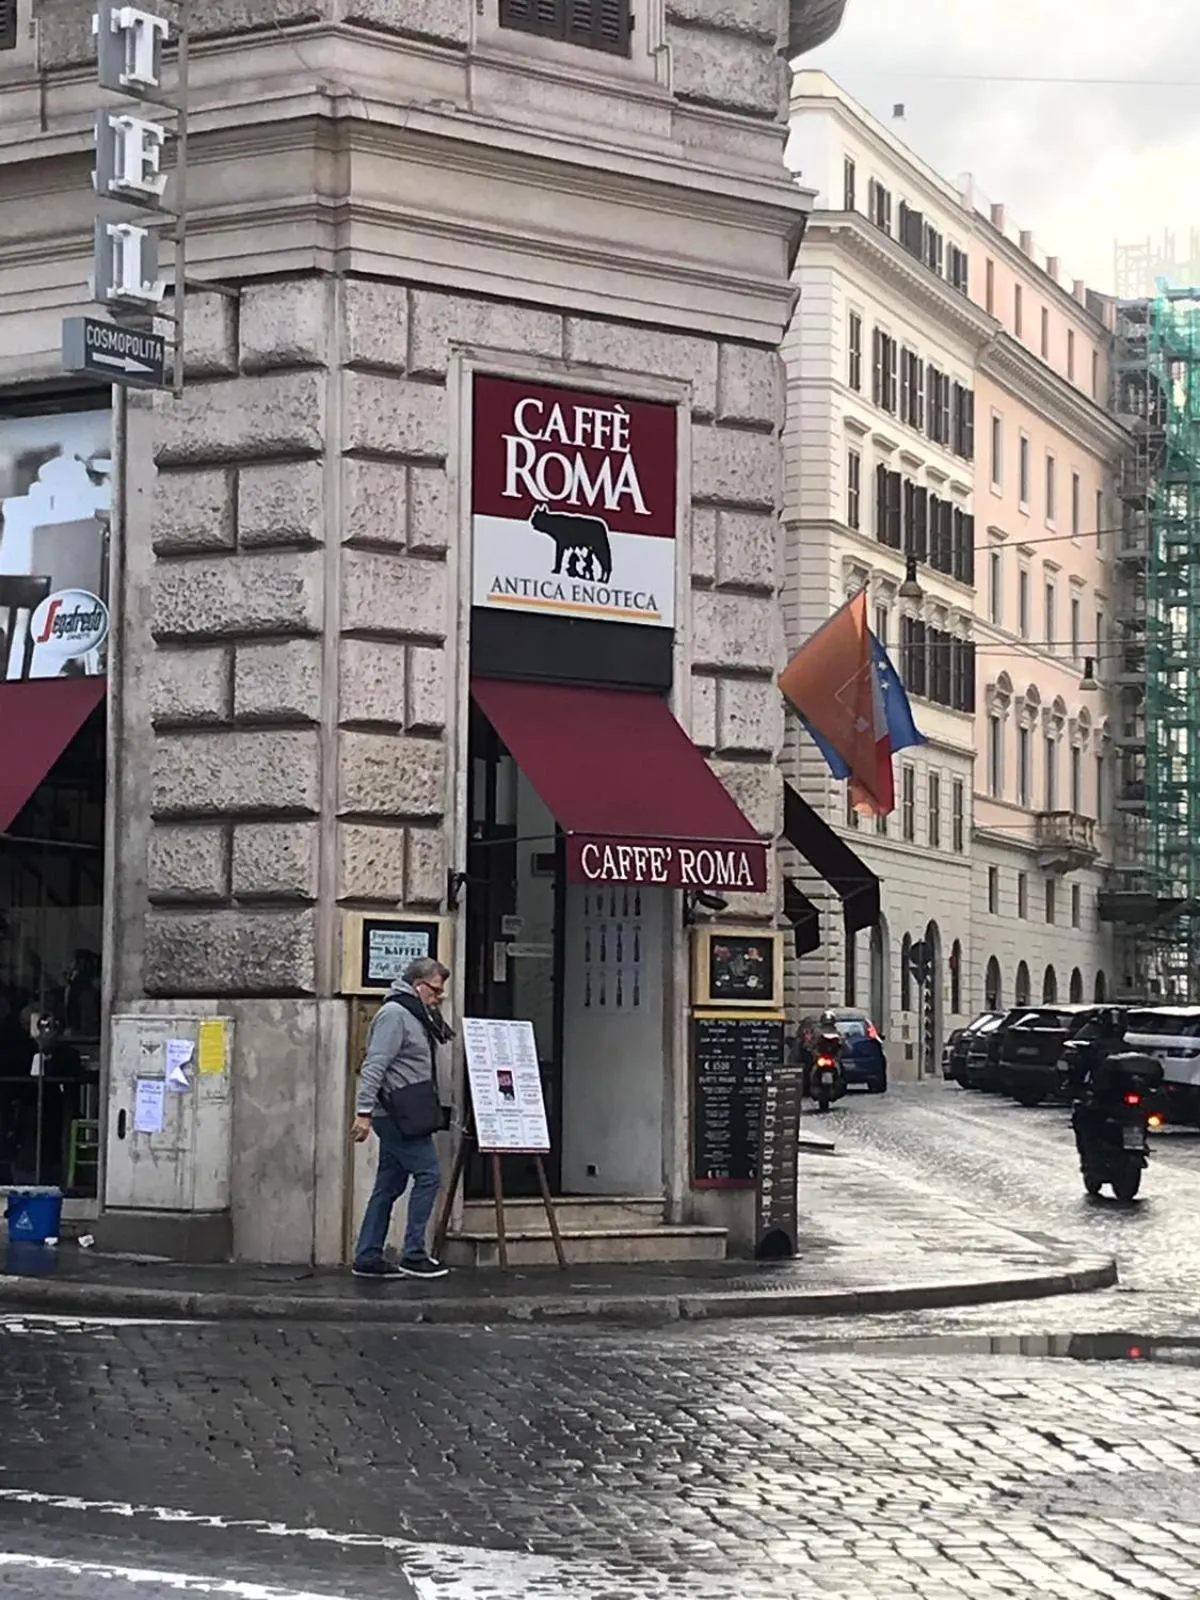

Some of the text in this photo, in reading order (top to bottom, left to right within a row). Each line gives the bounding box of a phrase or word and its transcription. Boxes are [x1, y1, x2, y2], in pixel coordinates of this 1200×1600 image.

[86, 324, 162, 362] COSMOPOLITA
[513, 398, 630, 453] CAFFÈ
[501, 434, 652, 515] ROMA
[491, 576, 564, 601] ANTICA
[572, 586, 658, 611] ENOTECA
[37, 598, 102, 643] Segafredo
[581, 843, 754, 886] CAFFE' ROMA
